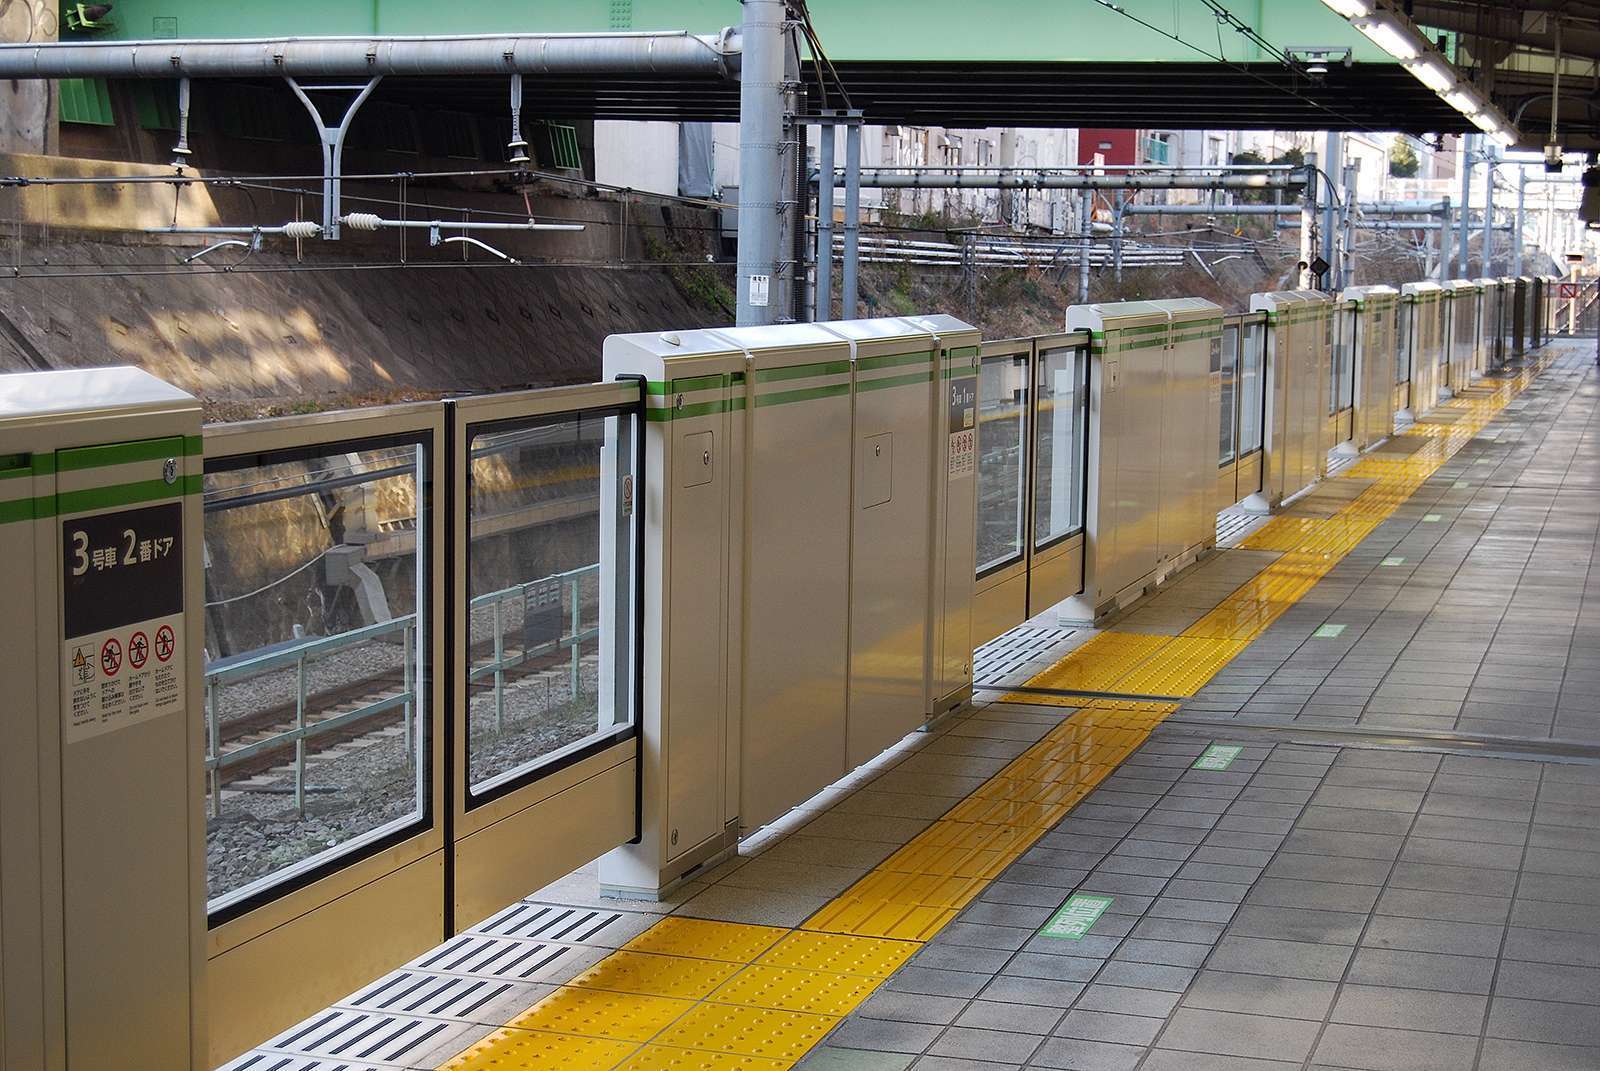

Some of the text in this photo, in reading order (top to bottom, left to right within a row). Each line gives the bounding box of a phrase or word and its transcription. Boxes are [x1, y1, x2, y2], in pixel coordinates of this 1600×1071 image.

[73, 529, 174, 575] 3号車 2番ドア
